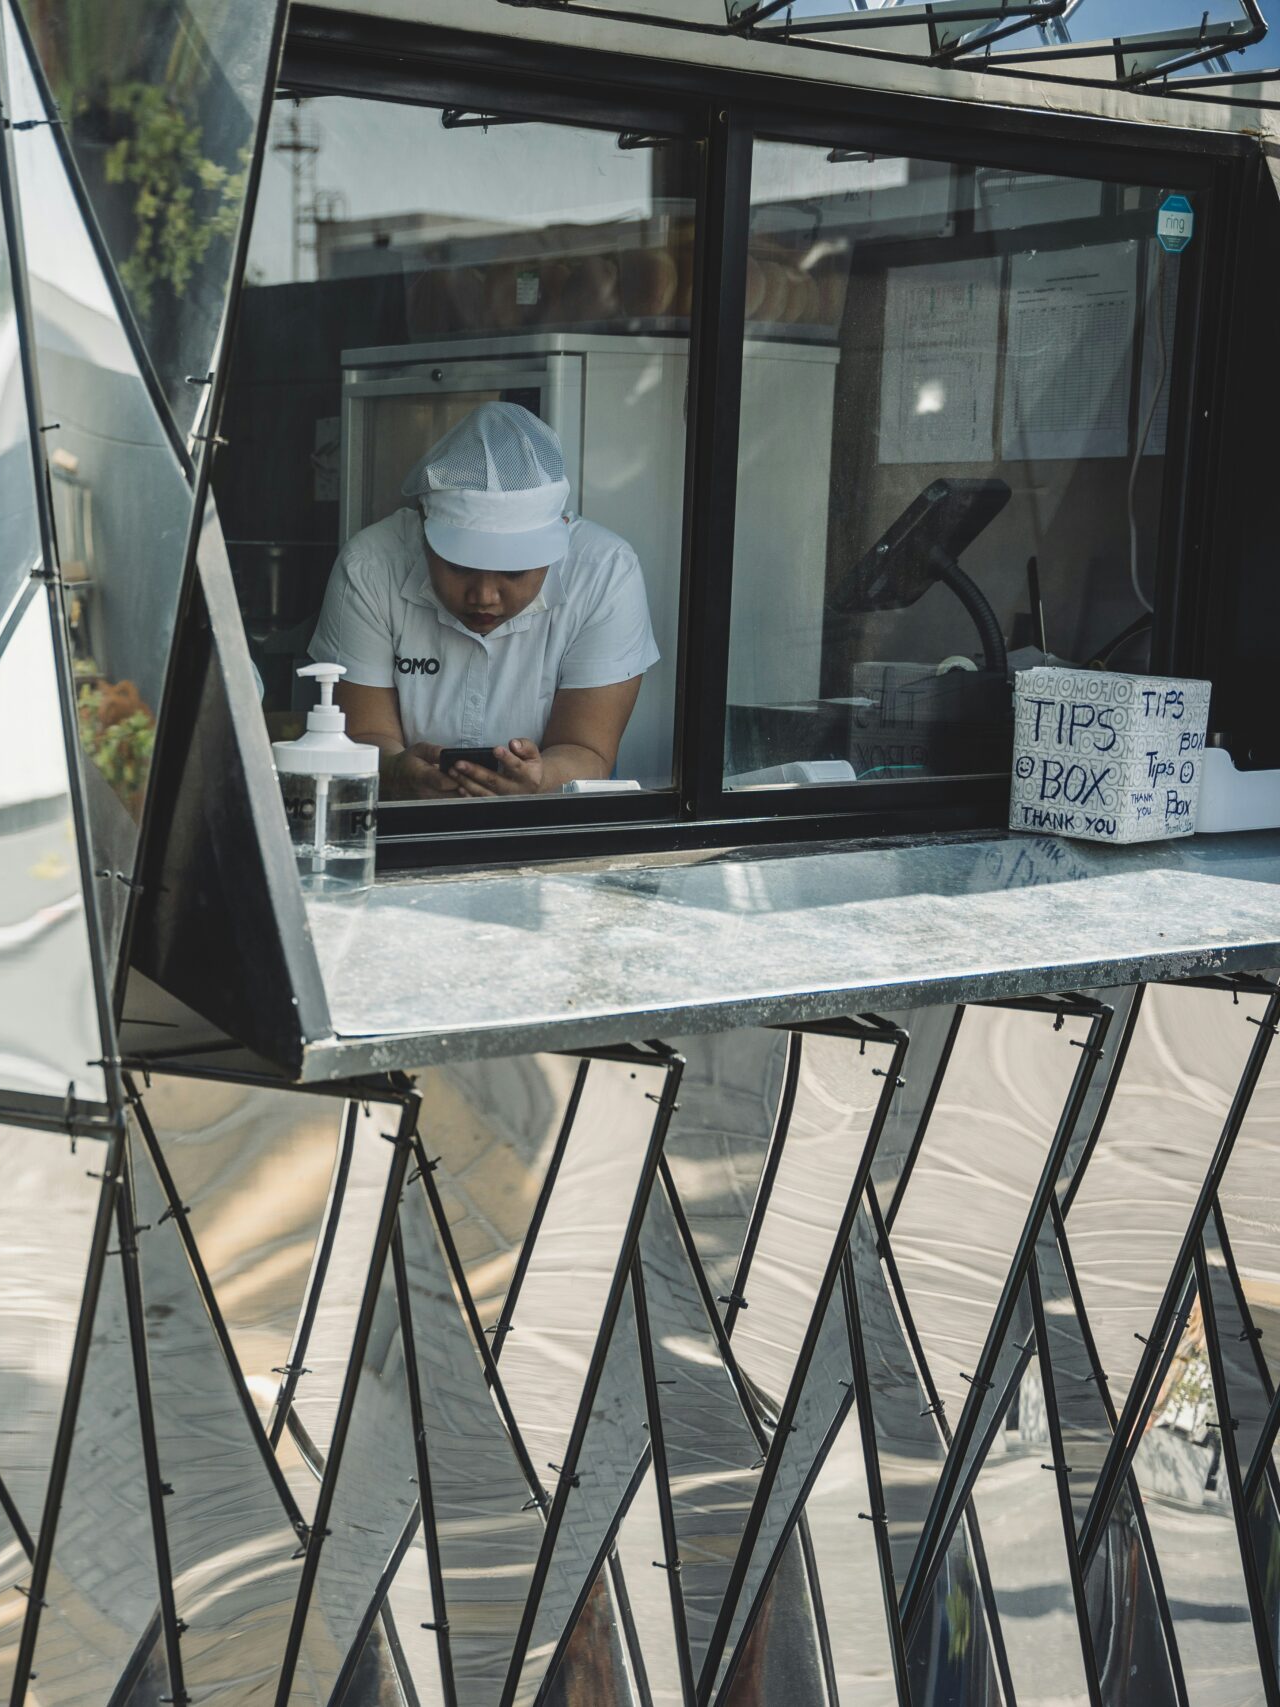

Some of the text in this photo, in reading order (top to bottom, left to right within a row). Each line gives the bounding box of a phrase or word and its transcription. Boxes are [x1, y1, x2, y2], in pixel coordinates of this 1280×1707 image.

[1166, 213, 1185, 234] ring
[1142, 689, 1185, 720] TIPS
[1024, 698, 1117, 751] TIPS
[1178, 731, 1206, 757] BOX
[1039, 759, 1111, 807] BOX
[1145, 750, 1176, 789] Tips
[1130, 792, 1154, 805] THANK
[1022, 806, 1117, 835] THANK YOU
[1136, 806, 1152, 821] YOU
